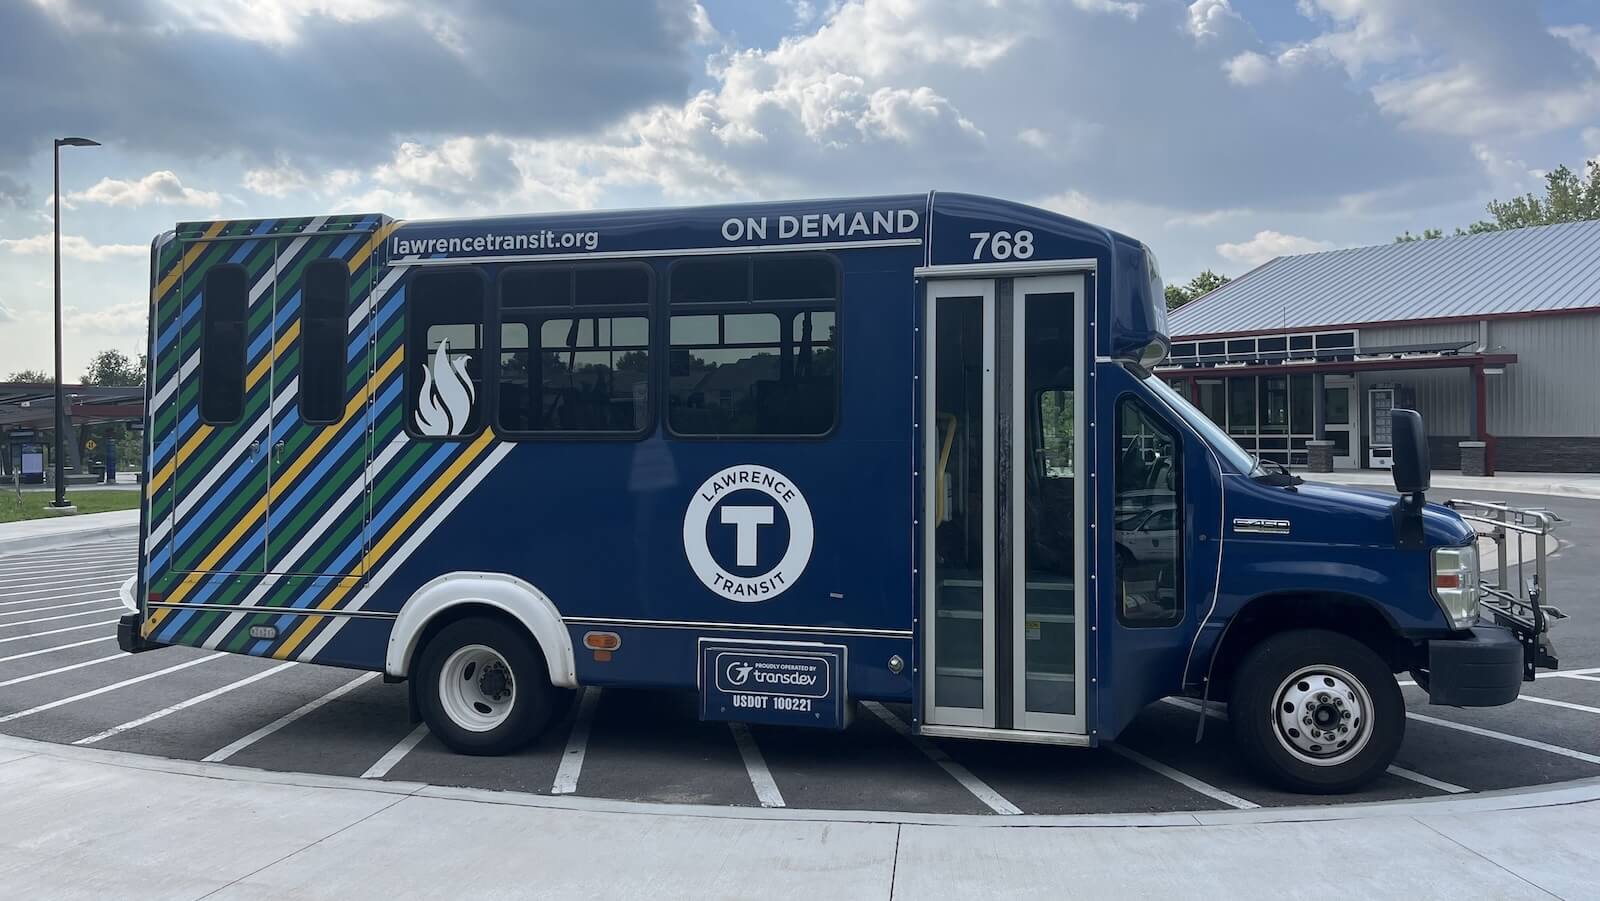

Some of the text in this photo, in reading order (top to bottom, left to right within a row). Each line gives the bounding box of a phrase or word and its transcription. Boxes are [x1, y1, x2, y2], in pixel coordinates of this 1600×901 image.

[721, 209, 919, 241] ON DEMAND
[393, 229, 599, 255] lawrencetransit.org
[969, 230, 1034, 260] 768
[702, 471, 796, 503] LAWRENCE
[721, 506, 774, 566] T
[713, 571, 785, 596] TRANSIT
[753, 670, 817, 686] transdev
[755, 662, 780, 670] PROUDLY
[733, 694, 812, 711] USDOT 100221
